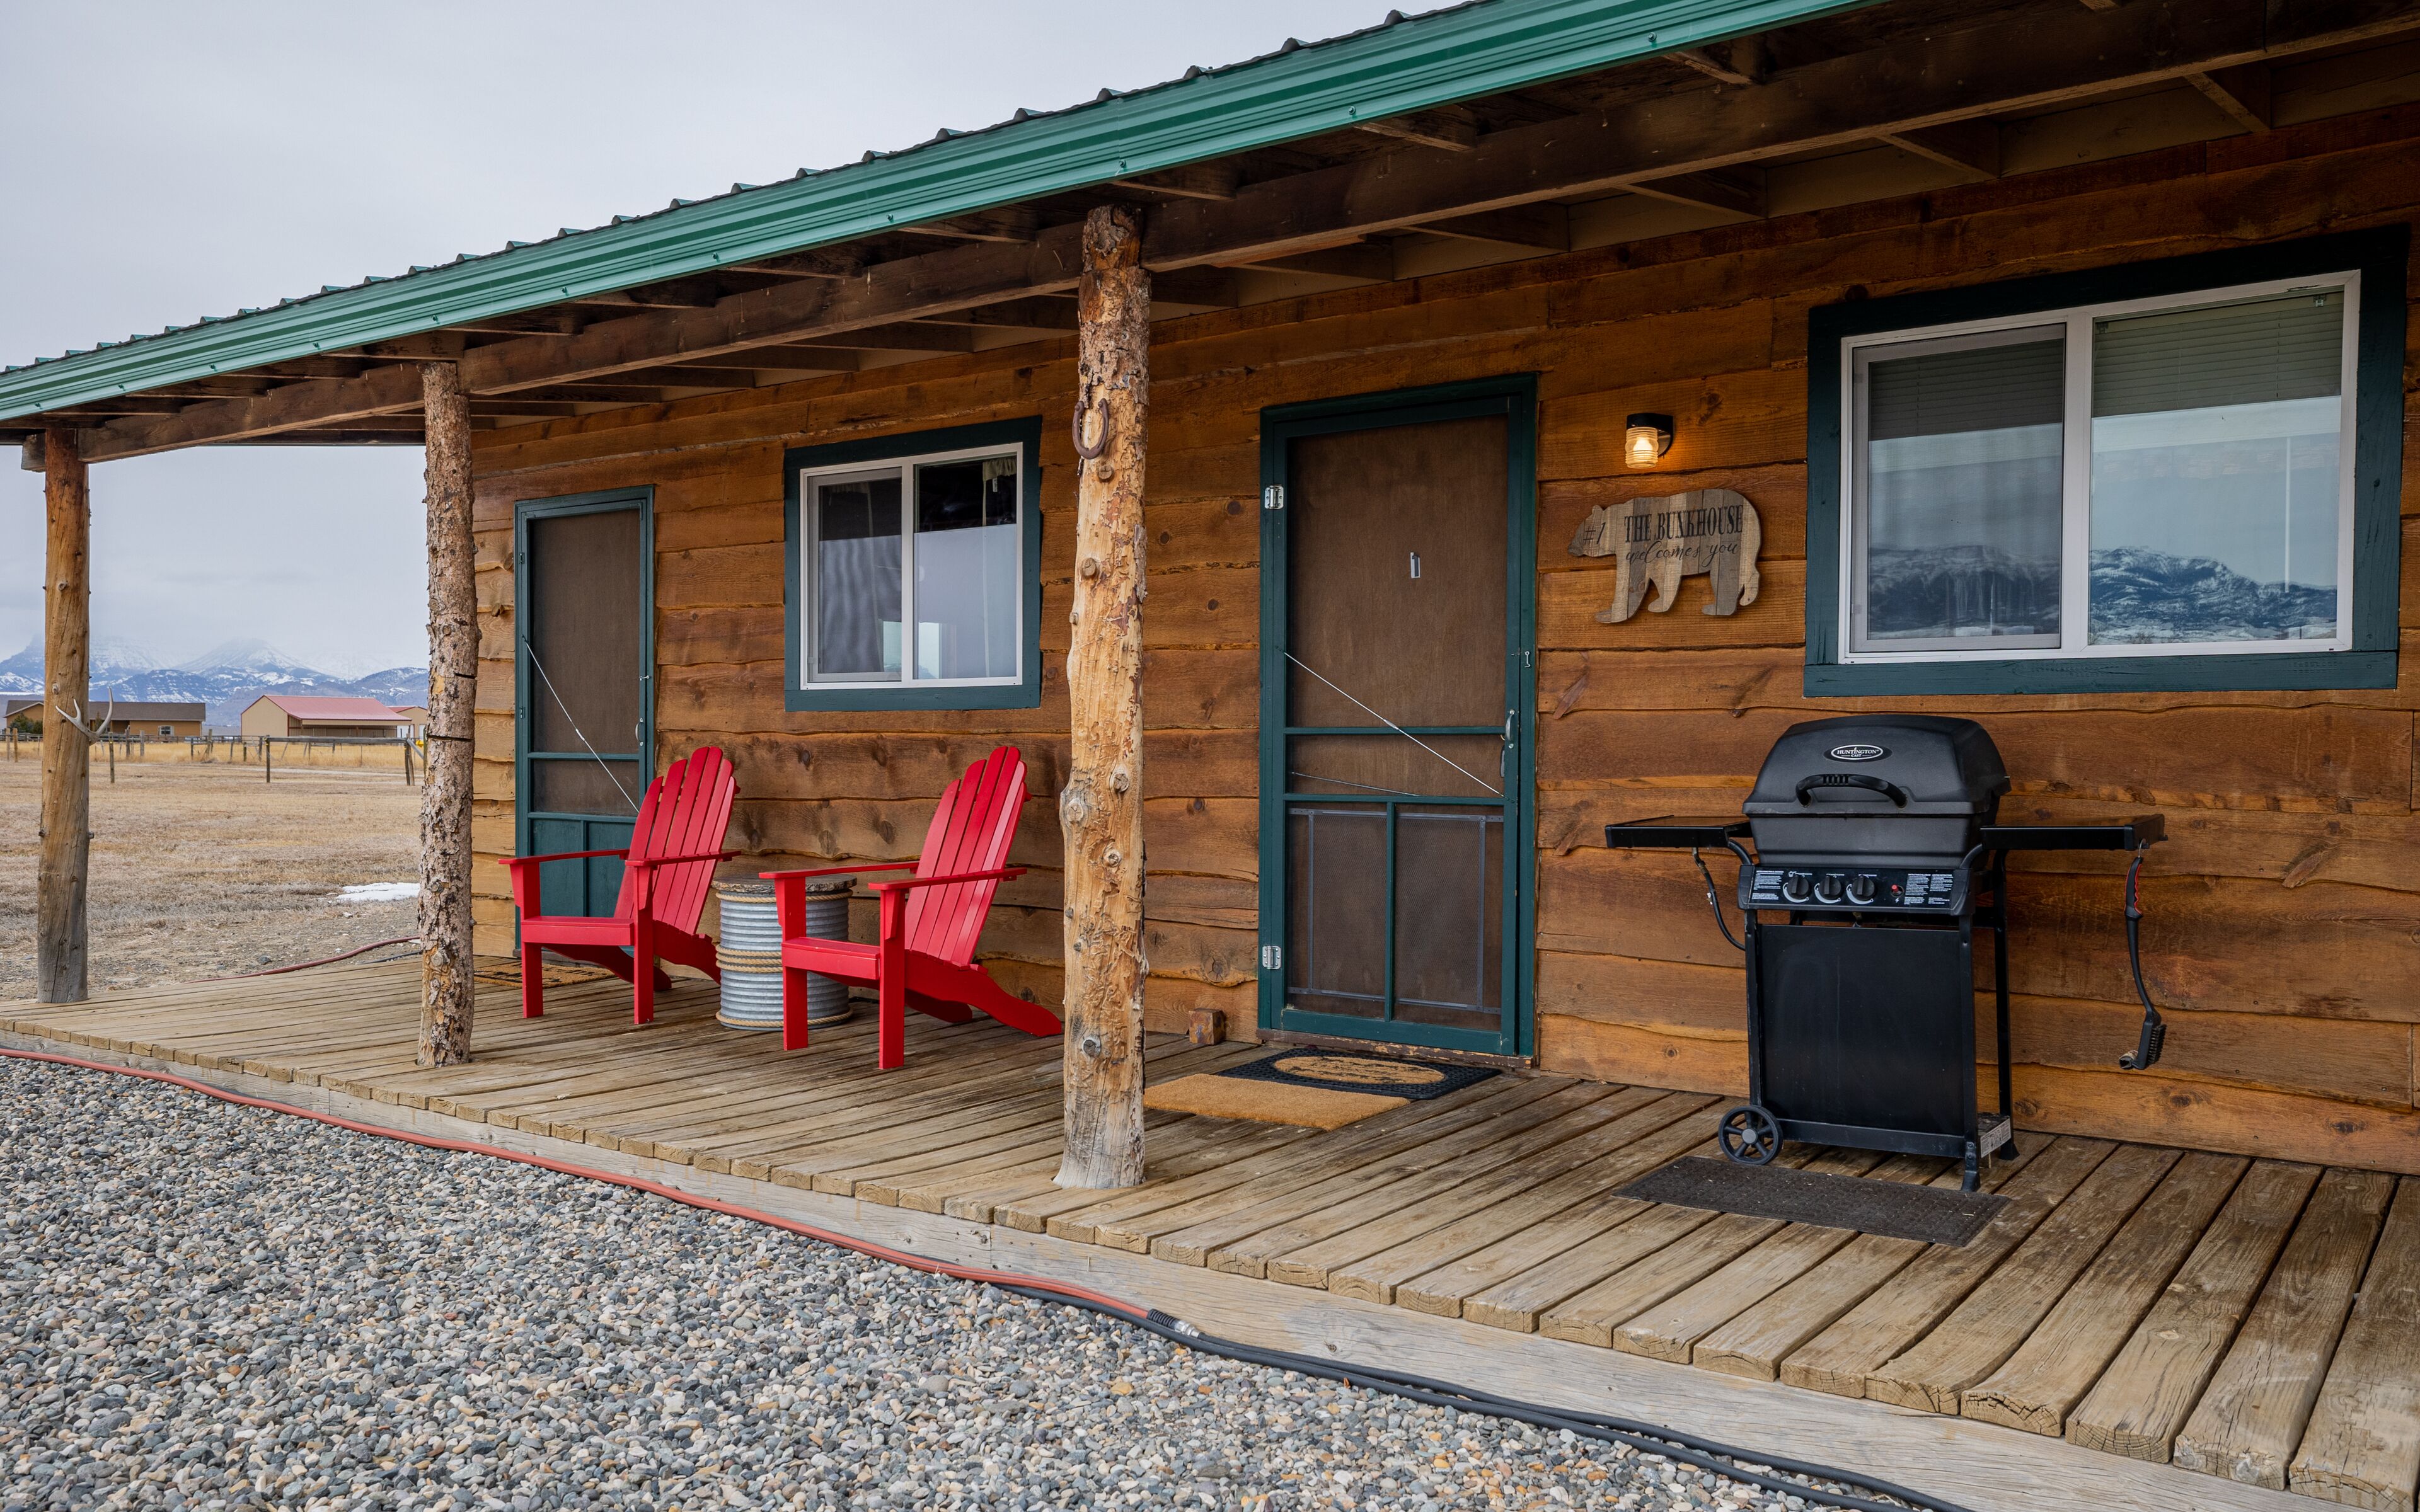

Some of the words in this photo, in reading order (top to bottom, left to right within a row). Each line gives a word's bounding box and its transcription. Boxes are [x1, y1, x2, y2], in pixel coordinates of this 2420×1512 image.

[1583, 522, 1606, 544] #1
[1624, 513, 1652, 542] THE
[1656, 505, 1743, 541] BUNKHOUSE
[1626, 541, 1700, 564] welcomes
[1702, 542, 1737, 567] you
